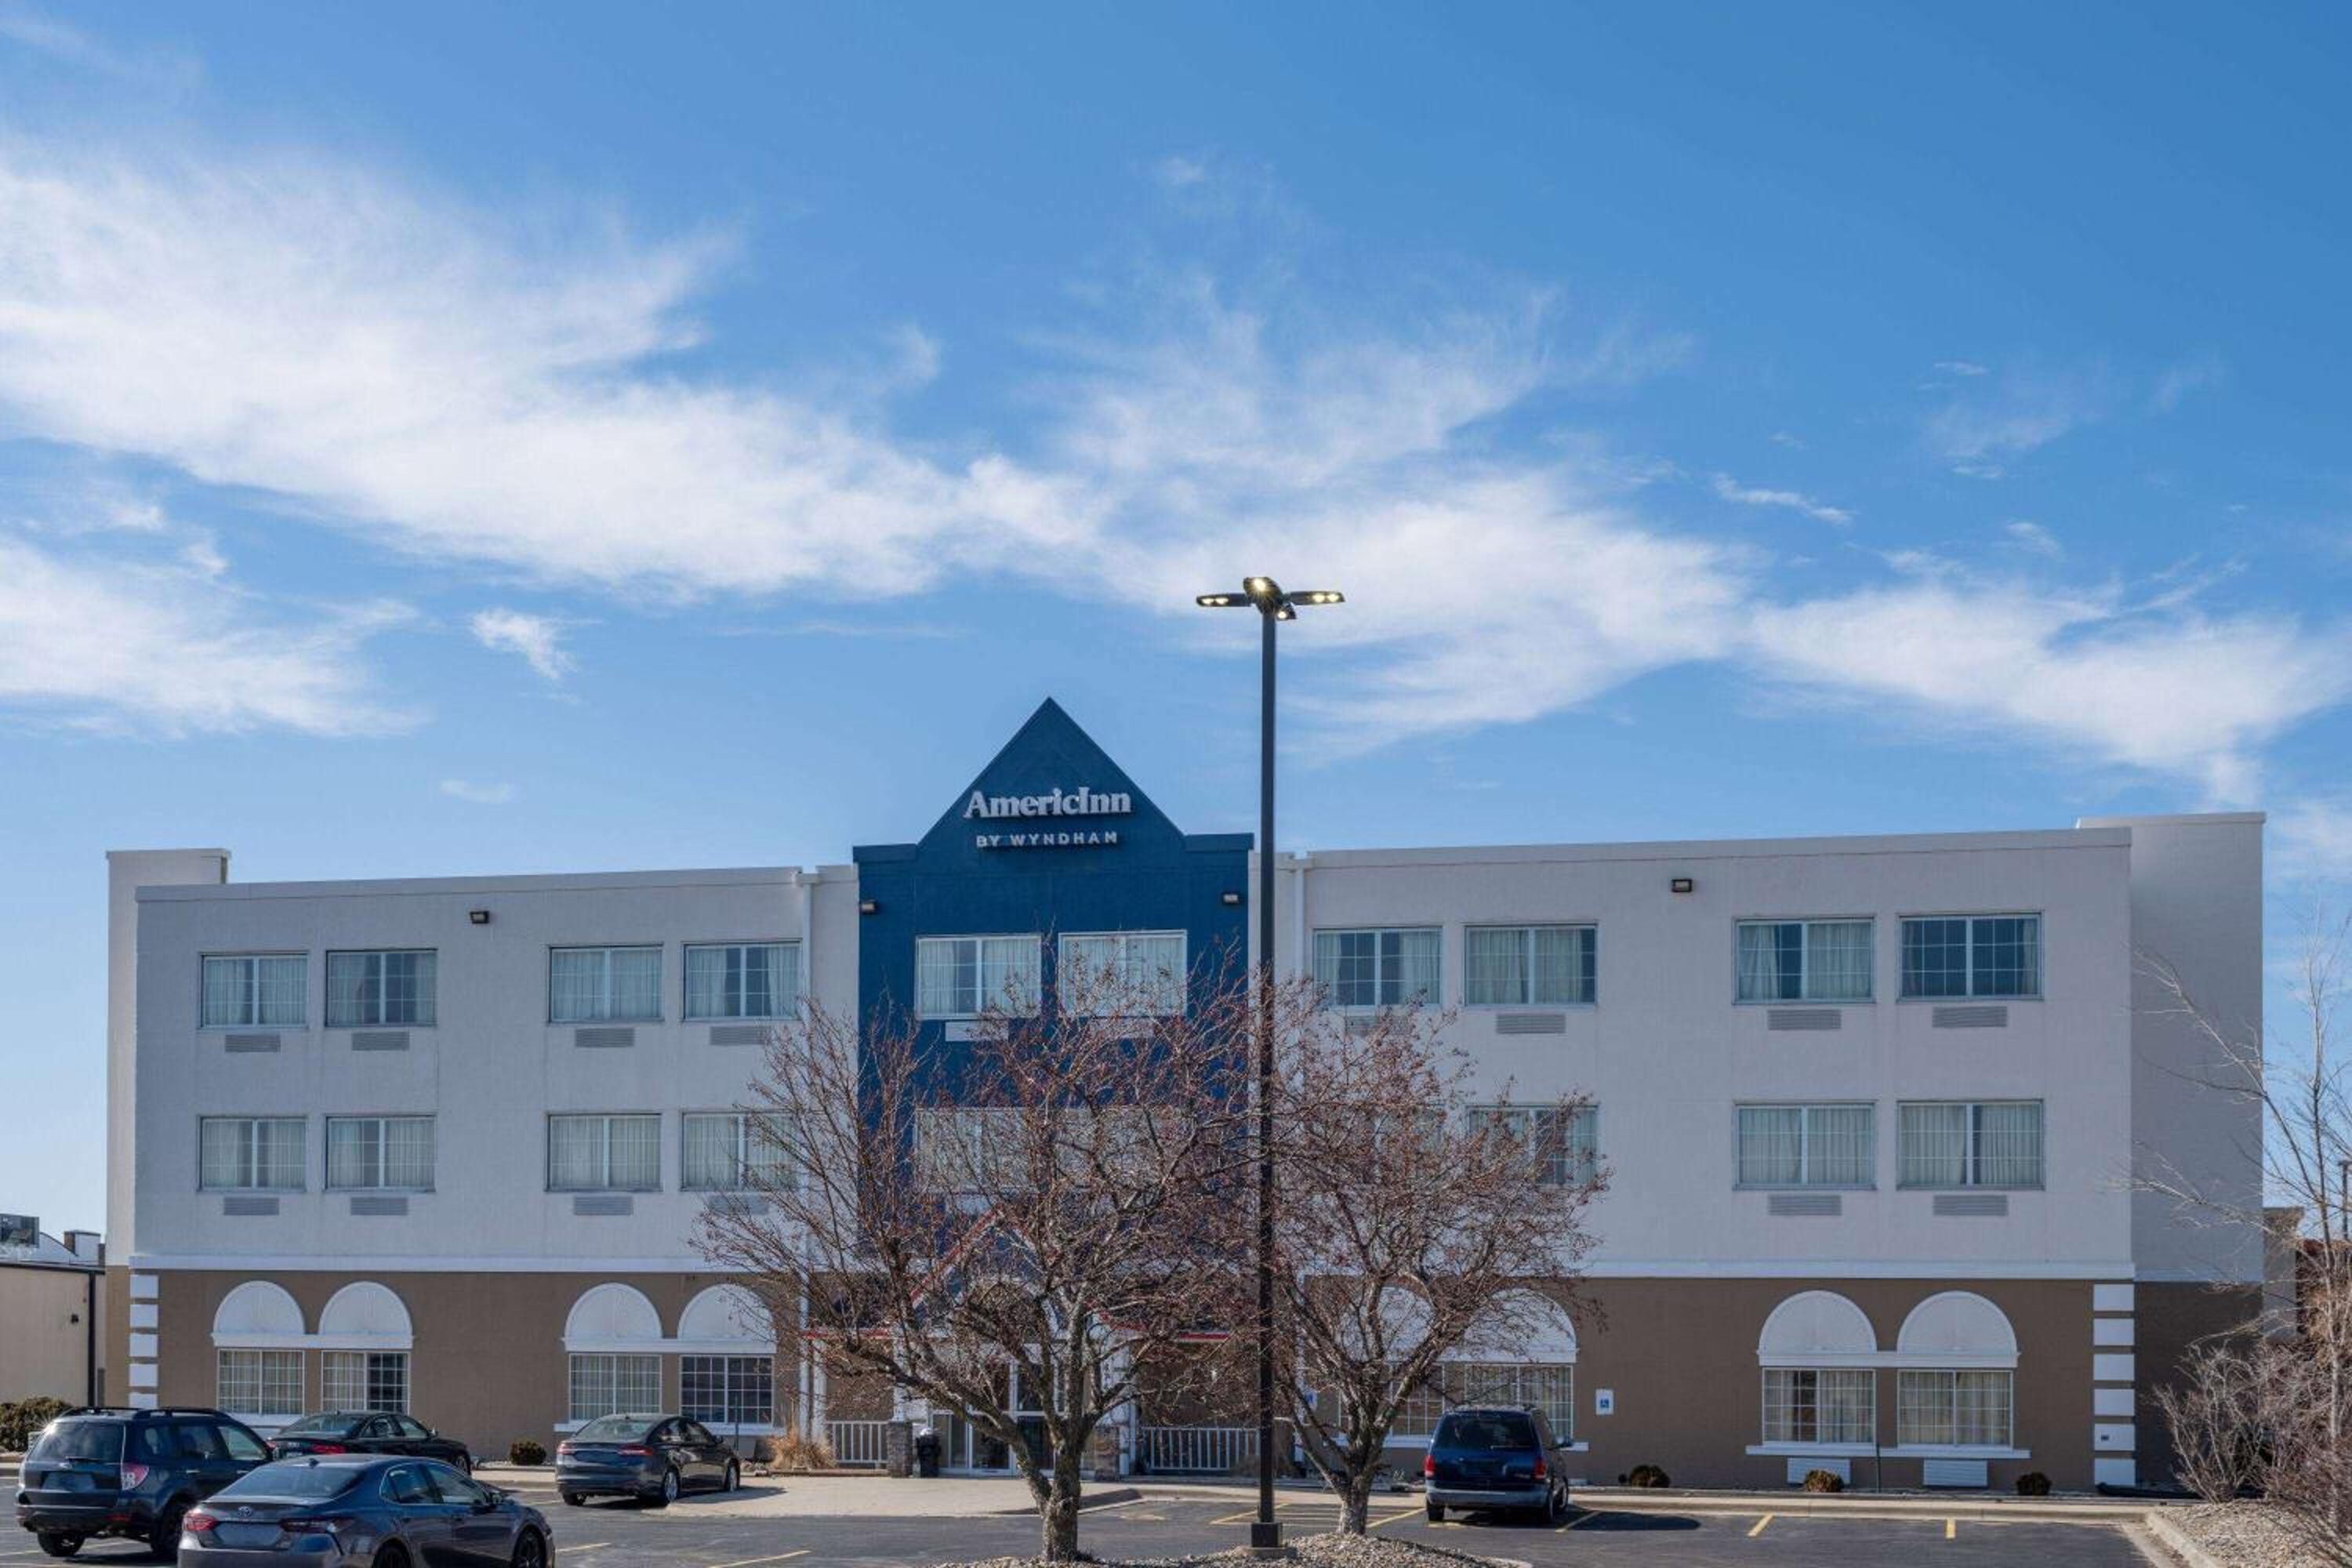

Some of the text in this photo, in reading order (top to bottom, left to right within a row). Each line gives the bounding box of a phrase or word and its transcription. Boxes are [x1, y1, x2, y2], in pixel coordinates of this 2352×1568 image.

[964, 786, 1131, 818] AmericInn
[977, 831, 1117, 848] BY WYNDHAM
